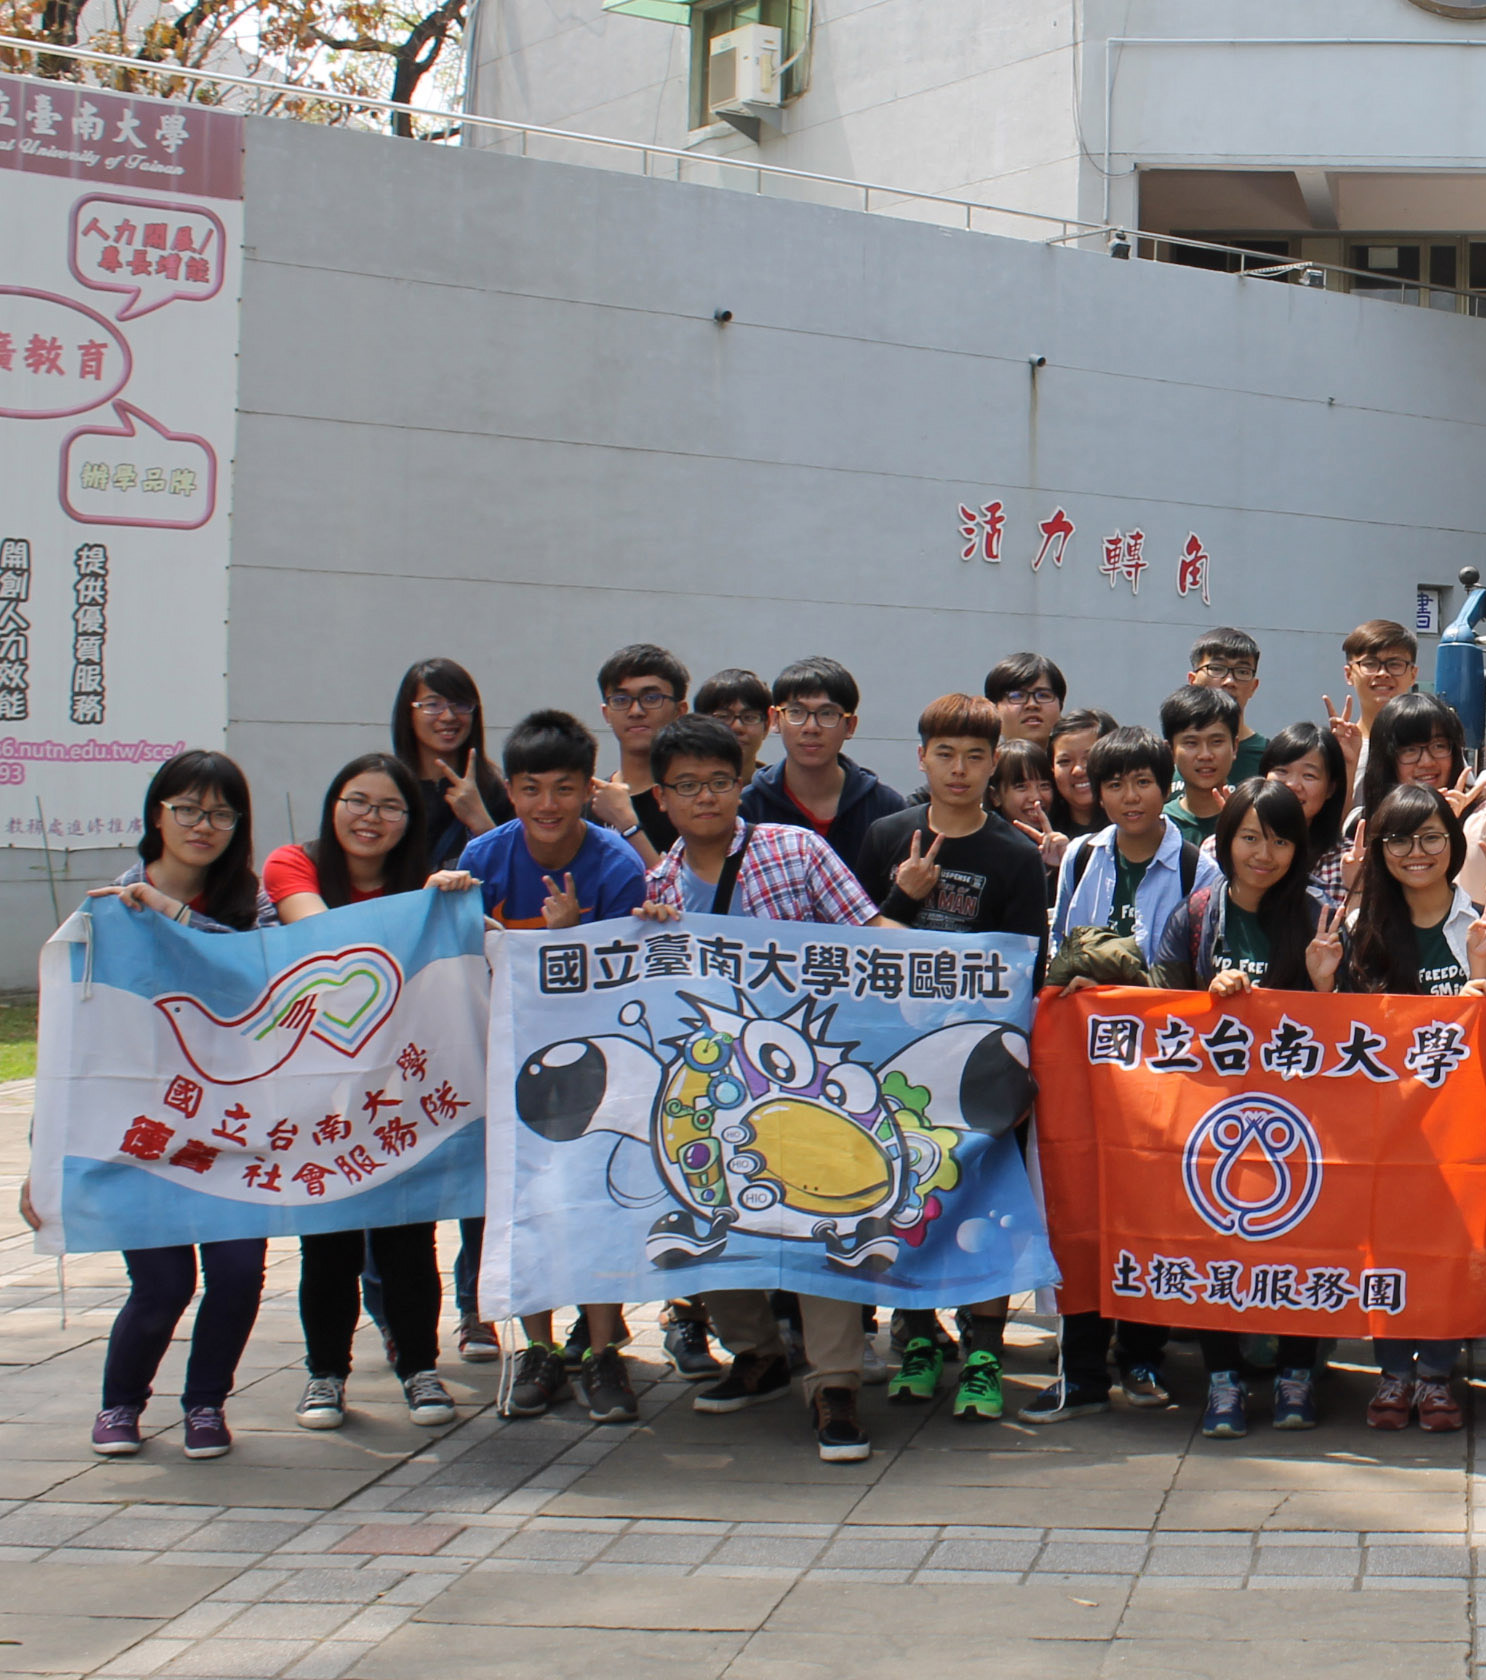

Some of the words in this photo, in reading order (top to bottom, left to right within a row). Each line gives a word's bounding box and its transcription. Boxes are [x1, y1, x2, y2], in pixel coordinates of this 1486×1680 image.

[18, 138, 100, 167] University
[104, 155, 125, 170] of
[125, 154, 185, 175] Tainan
[80, 461, 197, 497] 辦學品牌
[958, 500, 1211, 606] 活力轉角
[0, 538, 30, 721] 開創人力效能
[71, 543, 107, 725] 提供優質服務
[938, 889, 978, 916] MAN
[941, 871, 971, 883] USPENSE
[538, 933, 1010, 1001] 國立臺南大學海鷗社
[1212, 955, 1232, 970] ND
[1088, 1014, 1469, 1087] 國立台南大學
[164, 1042, 430, 1151] 國立台南大學
[1113, 1249, 1406, 1312] 土撥鼠服務團
